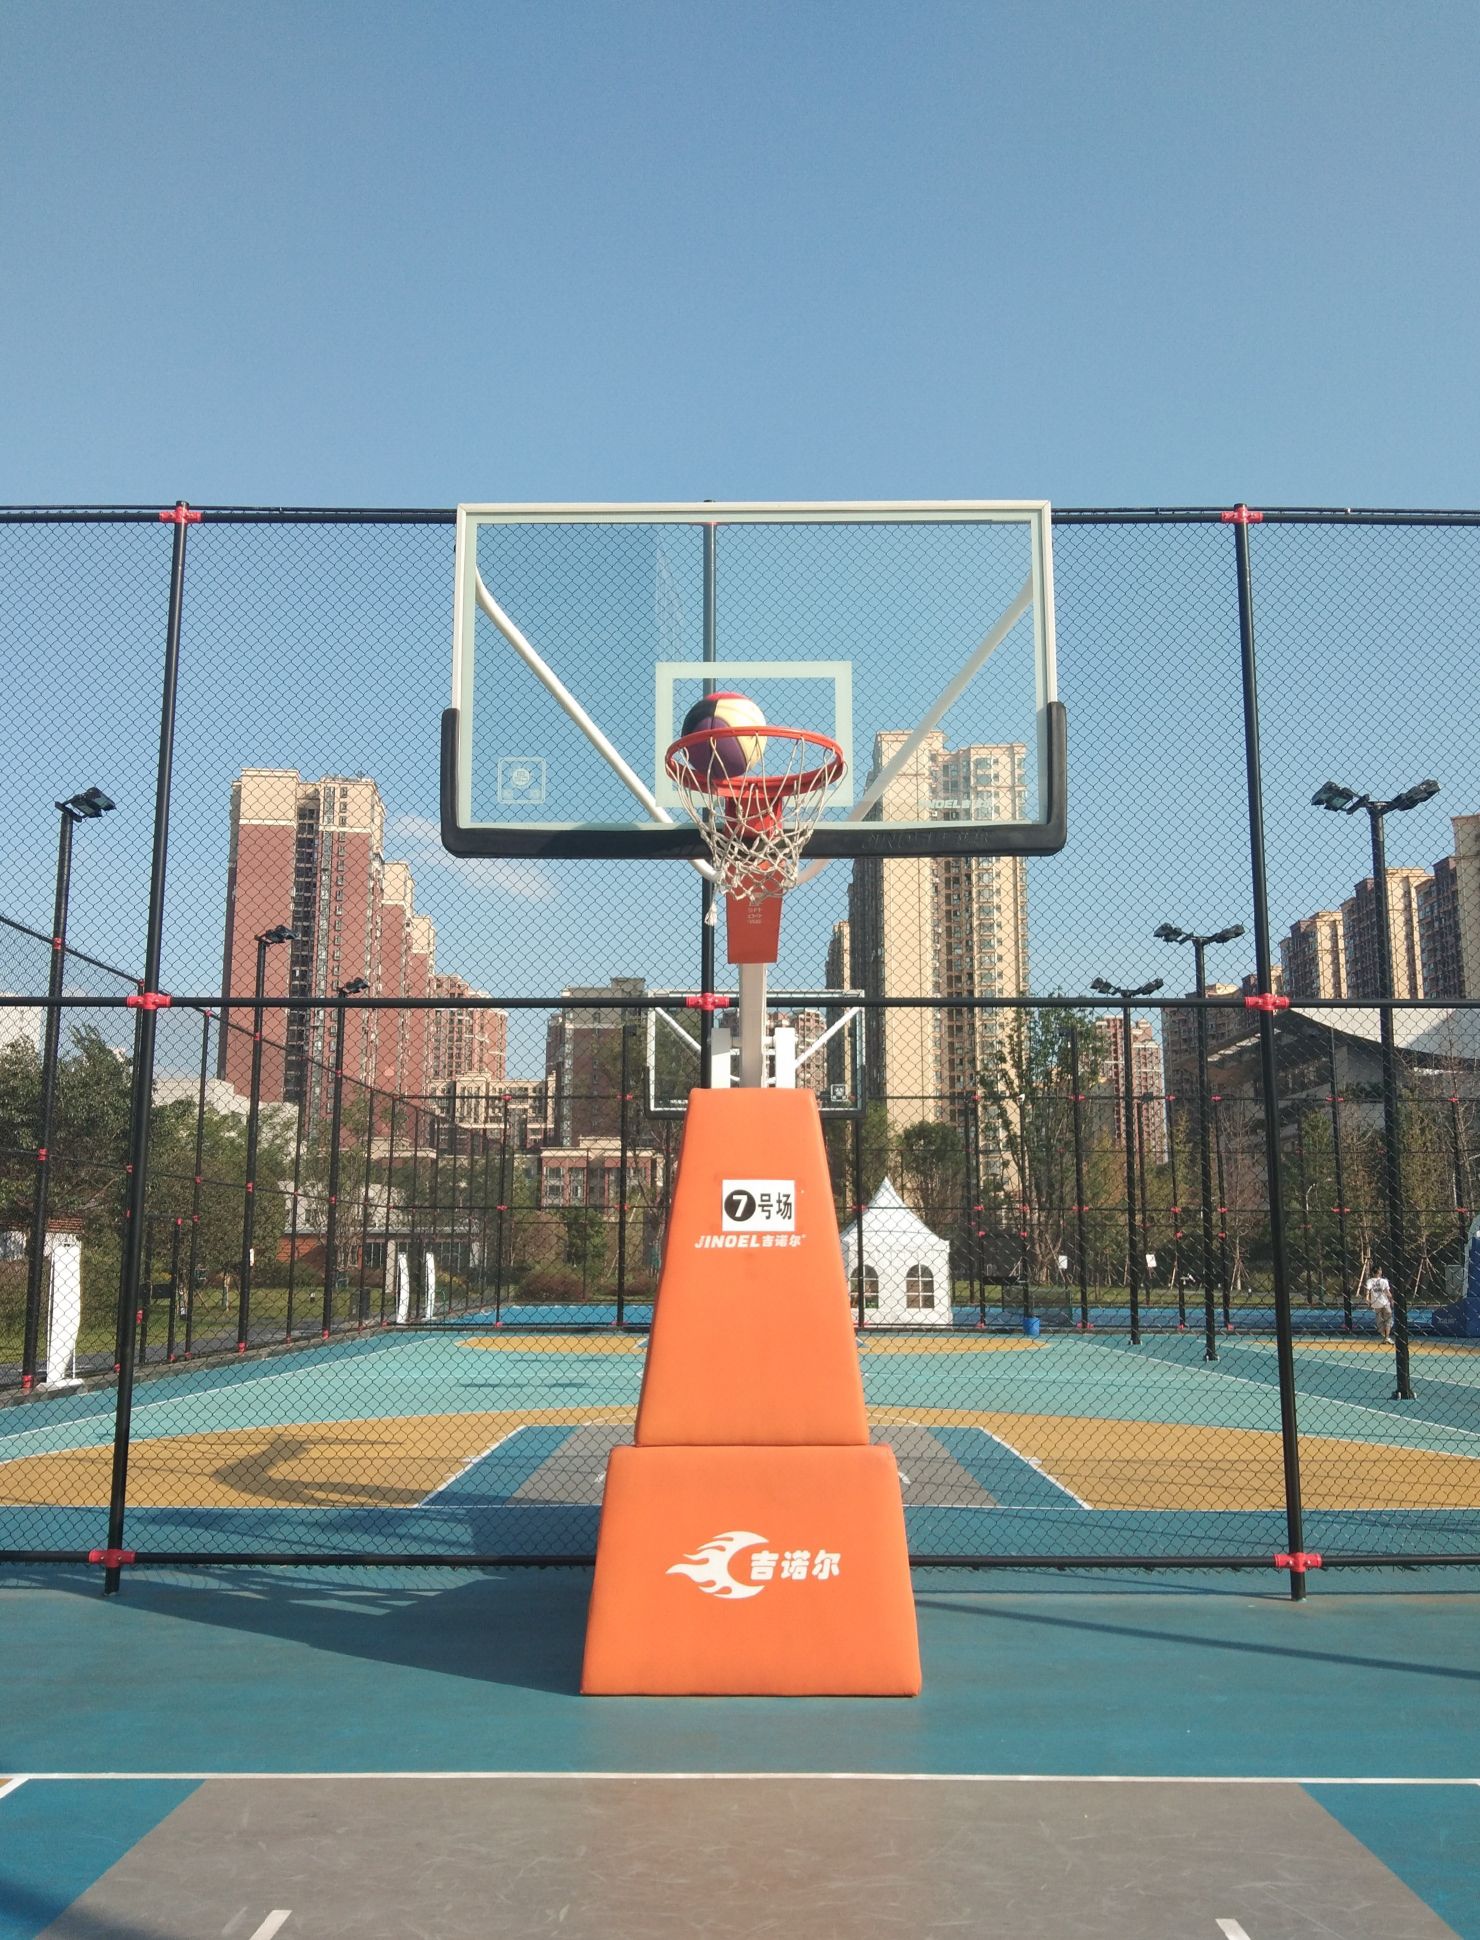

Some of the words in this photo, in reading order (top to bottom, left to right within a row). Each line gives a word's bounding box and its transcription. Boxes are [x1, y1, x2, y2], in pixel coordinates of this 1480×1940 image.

[918, 799, 961, 809] NOEL
[694, 1235, 760, 1248] JINOEL
[762, 1235, 801, 1247] 吉诺尔
[750, 1550, 841, 1580] 吉诺尔
